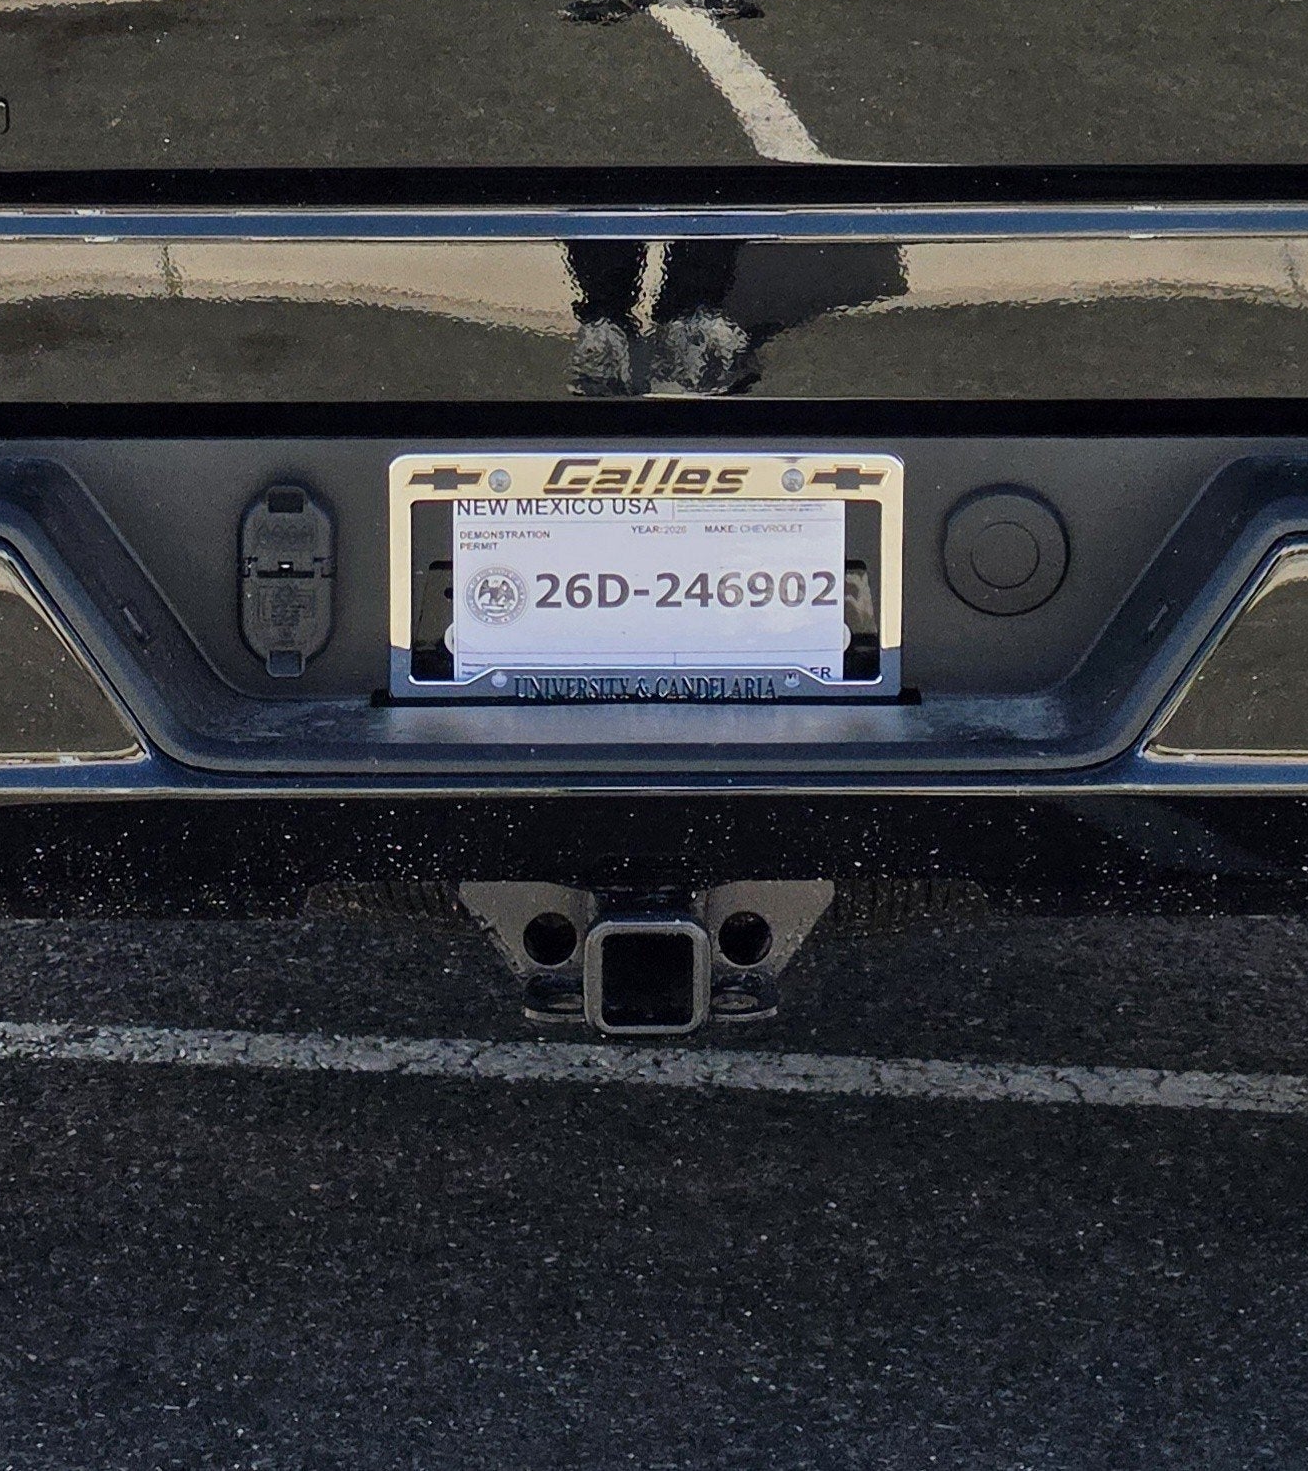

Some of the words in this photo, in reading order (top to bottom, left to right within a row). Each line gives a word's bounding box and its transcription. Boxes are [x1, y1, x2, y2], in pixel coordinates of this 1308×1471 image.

[543, 458, 750, 495] Galles
[457, 500, 508, 515] NEW
[516, 500, 604, 515] MEXICO
[612, 500, 659, 515] USA
[459, 530, 551, 540] DEMONSTRATION
[459, 542, 498, 551] PERMIT
[535, 571, 839, 609] 26D-246902
[514, 675, 630, 699] UNIVERSITY
[635, 675, 653, 699] &
[656, 675, 778, 699] CANDELARIA
